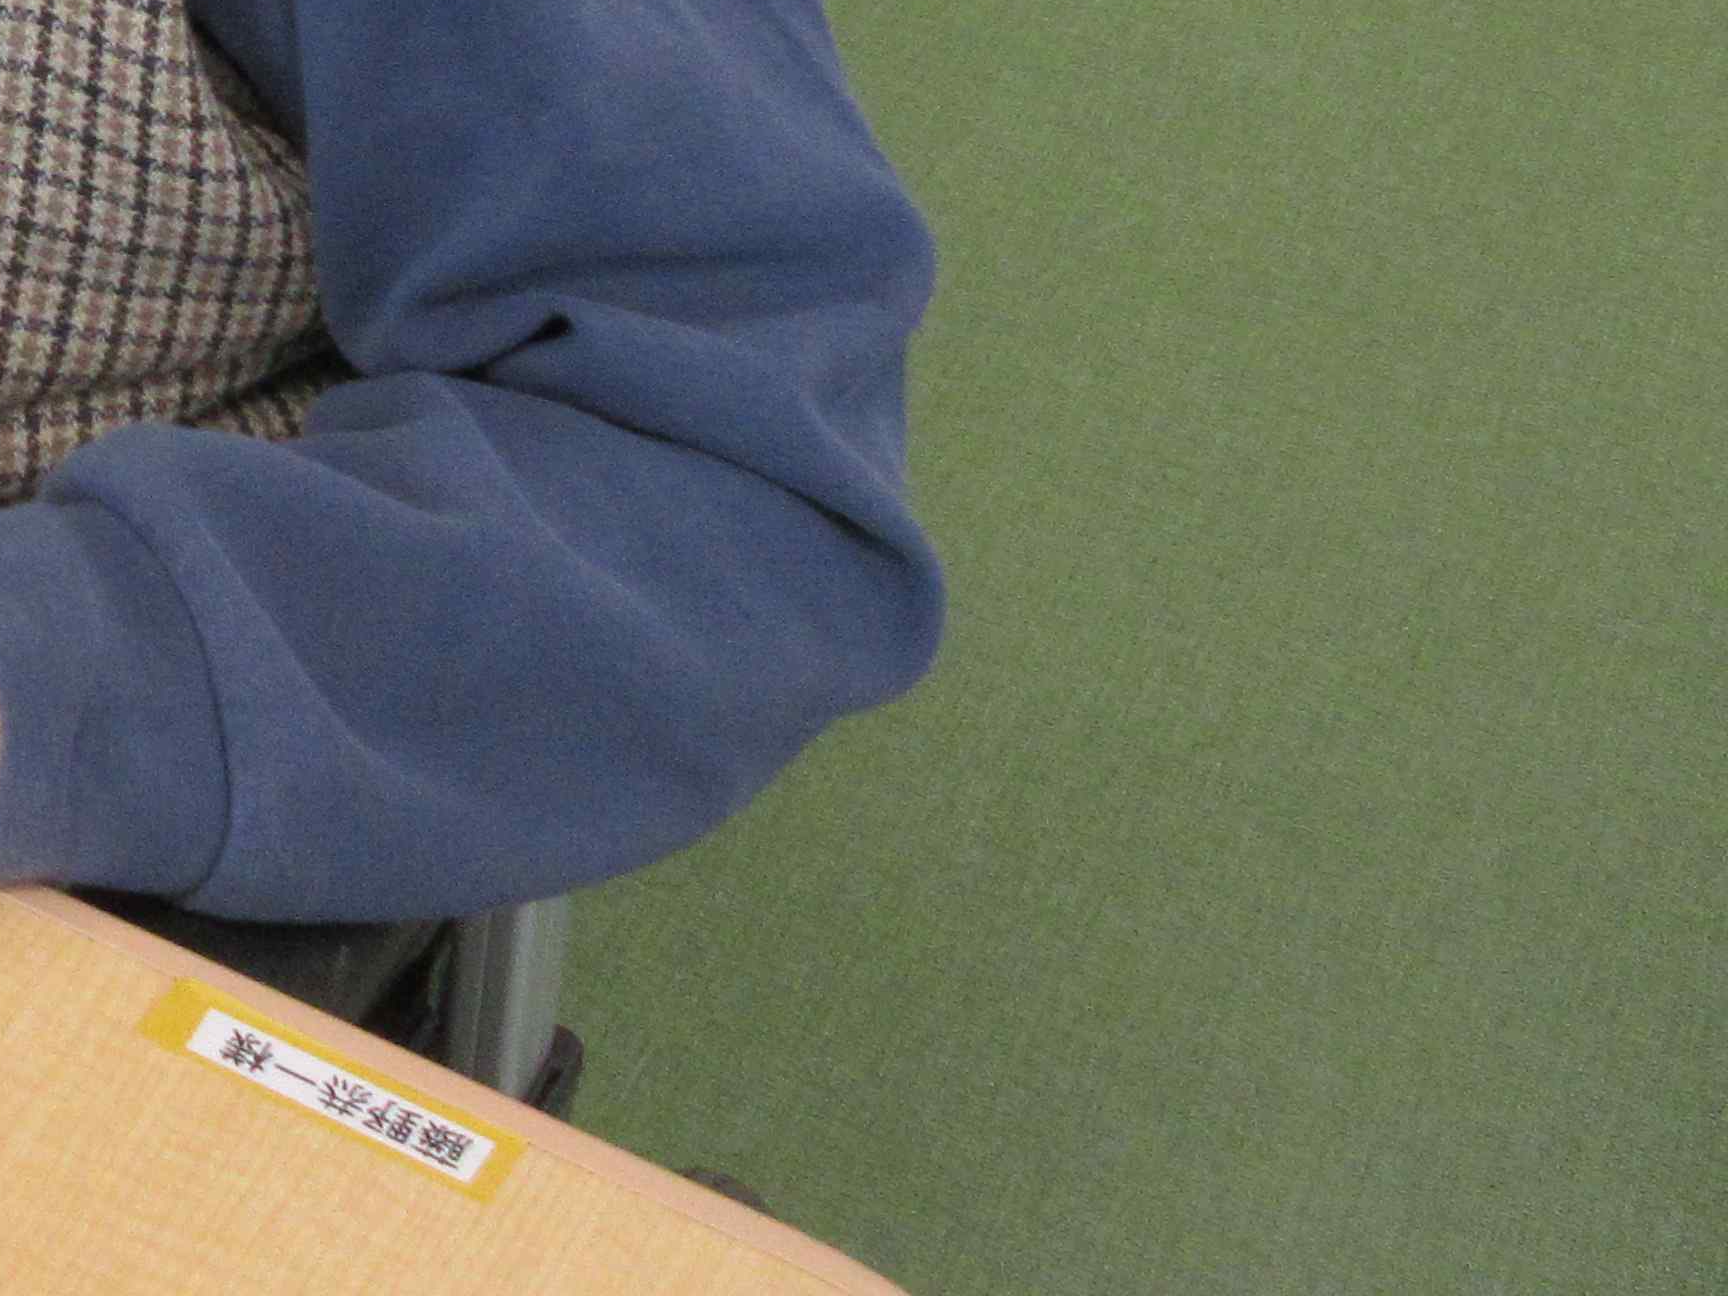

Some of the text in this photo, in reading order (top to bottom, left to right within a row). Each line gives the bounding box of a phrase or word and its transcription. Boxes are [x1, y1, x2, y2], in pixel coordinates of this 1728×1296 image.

[218, 1027, 473, 1170] 藤野恭一様
